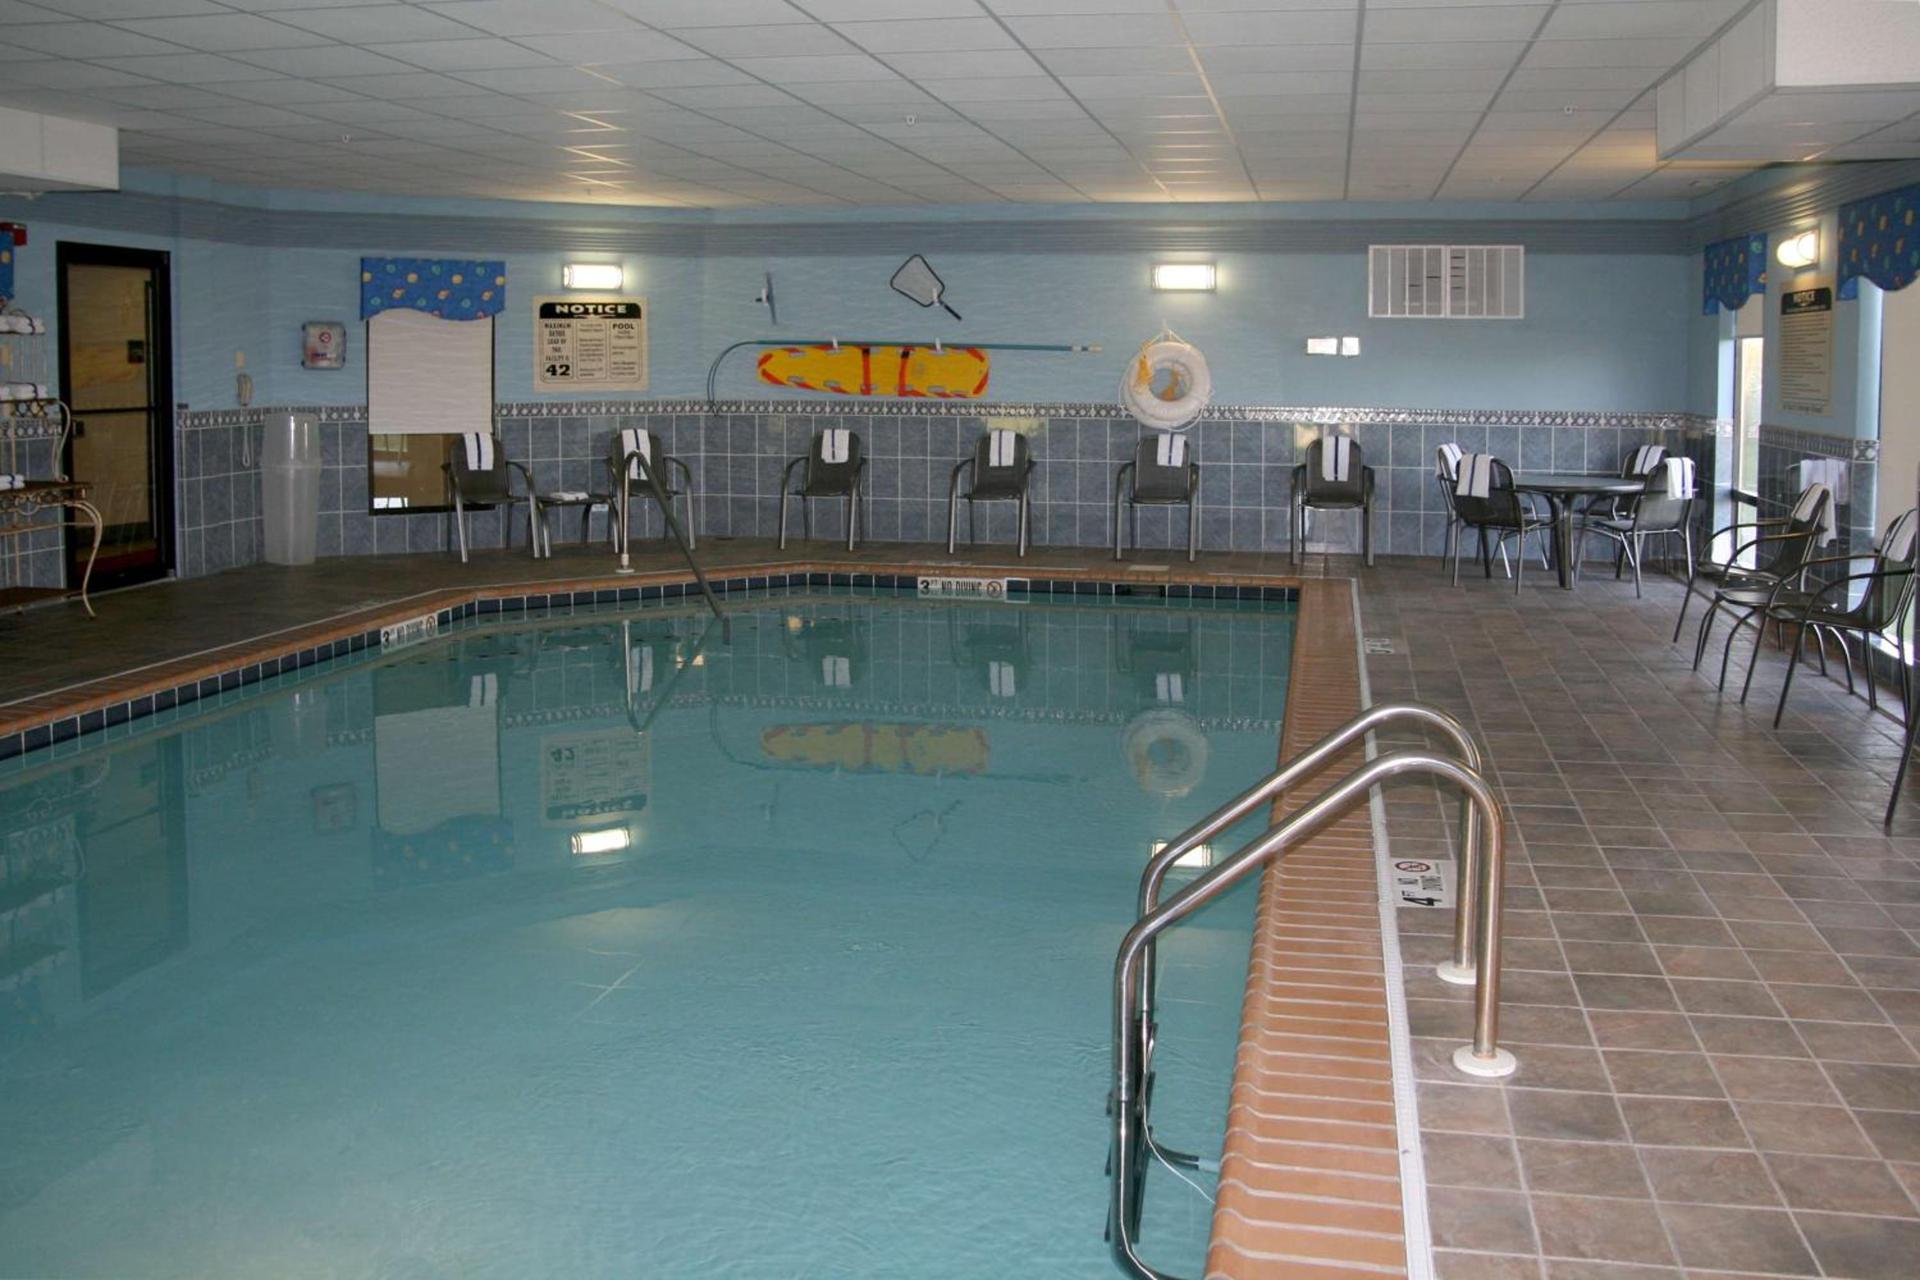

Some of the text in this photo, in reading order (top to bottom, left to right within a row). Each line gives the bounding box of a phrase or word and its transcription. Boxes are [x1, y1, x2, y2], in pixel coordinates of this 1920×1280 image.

[555, 304, 627, 314] NOTICE
[545, 364, 570, 376] 42
[1402, 897, 1442, 906] 4
